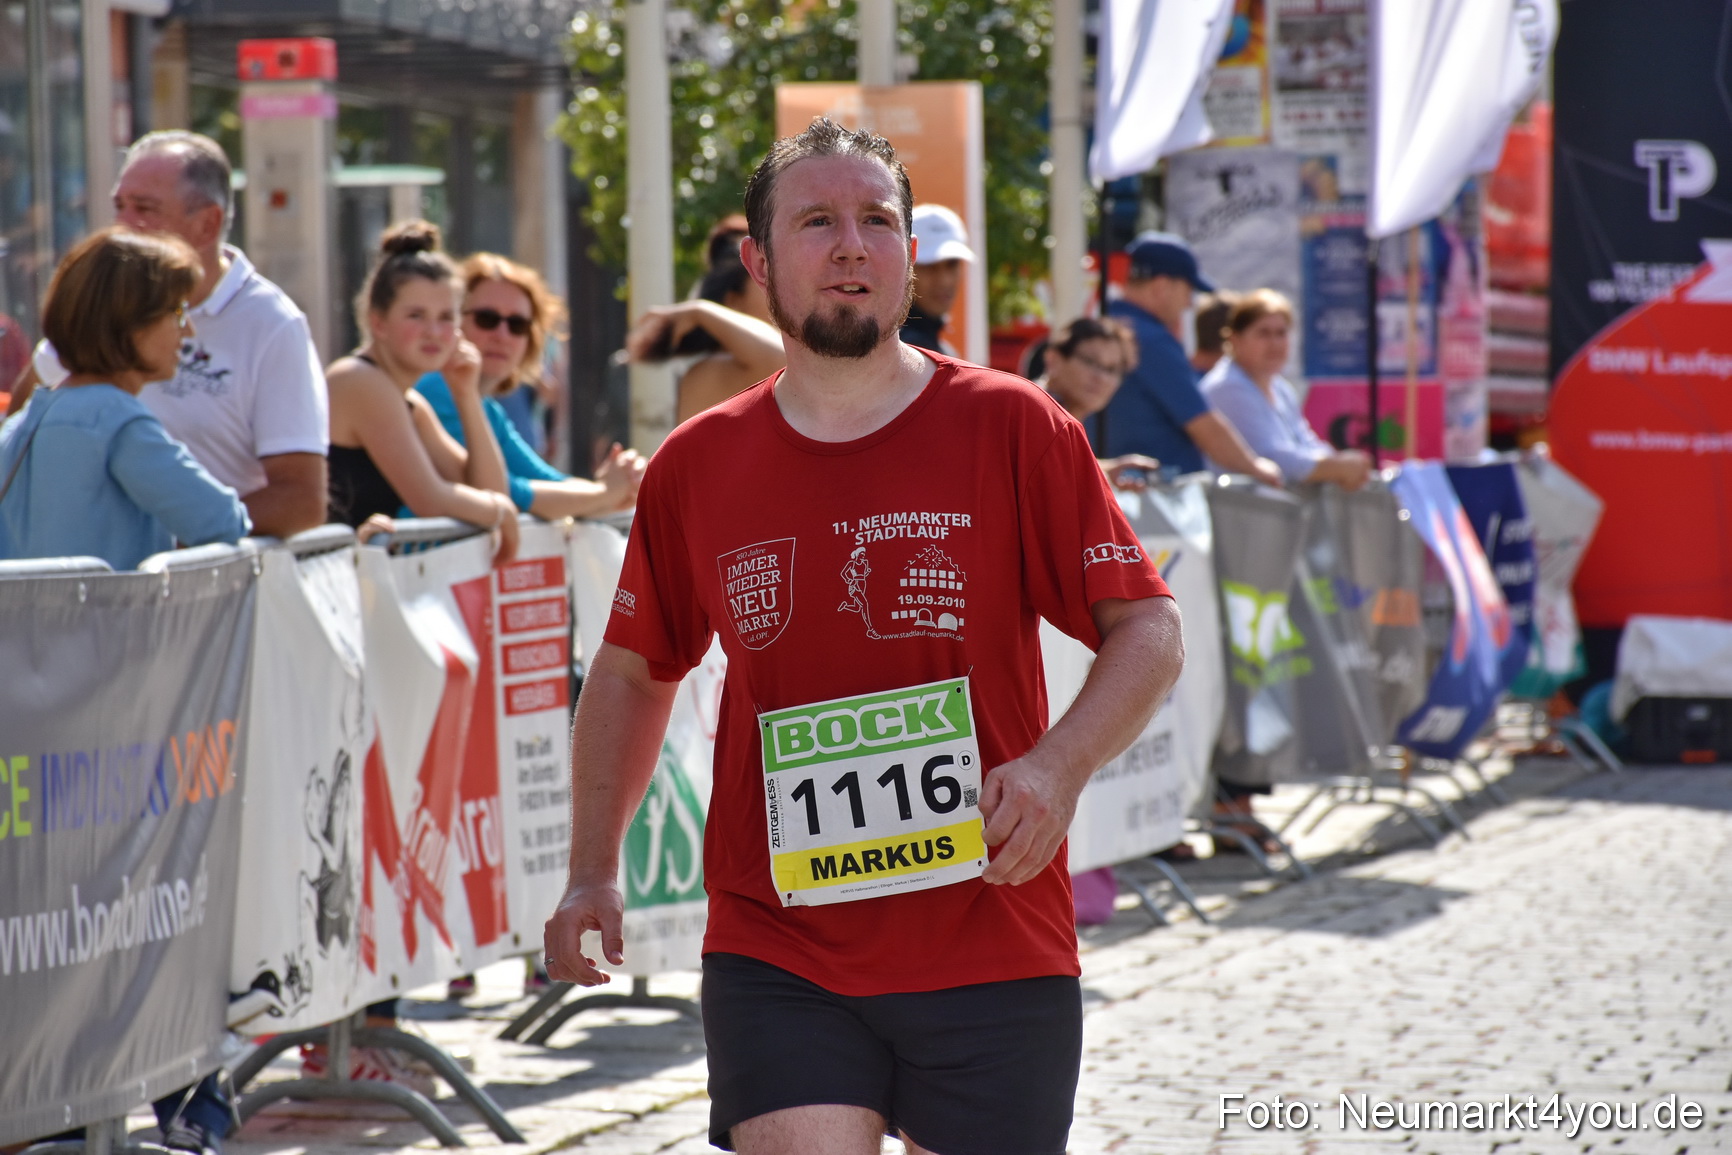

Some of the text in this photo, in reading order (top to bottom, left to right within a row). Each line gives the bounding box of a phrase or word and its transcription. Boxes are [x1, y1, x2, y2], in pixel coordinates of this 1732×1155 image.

[832, 511, 972, 535] 11. NEUMARKTER
[854, 525, 950, 546] STADTLAUF
[748, 548, 767, 558] Jahre
[727, 554, 779, 580] IMMER
[726, 569, 782, 596] WIEDER
[729, 587, 778, 619] NEU
[897, 594, 965, 609] 19.09.2010
[736, 611, 781, 635] MARKT
[882, 629, 965, 642] www.stadtlauf-neumarkt.de
[772, 690, 958, 764] BOCK
[790, 754, 962, 836] 1116
[809, 835, 955, 882] MARKUS
